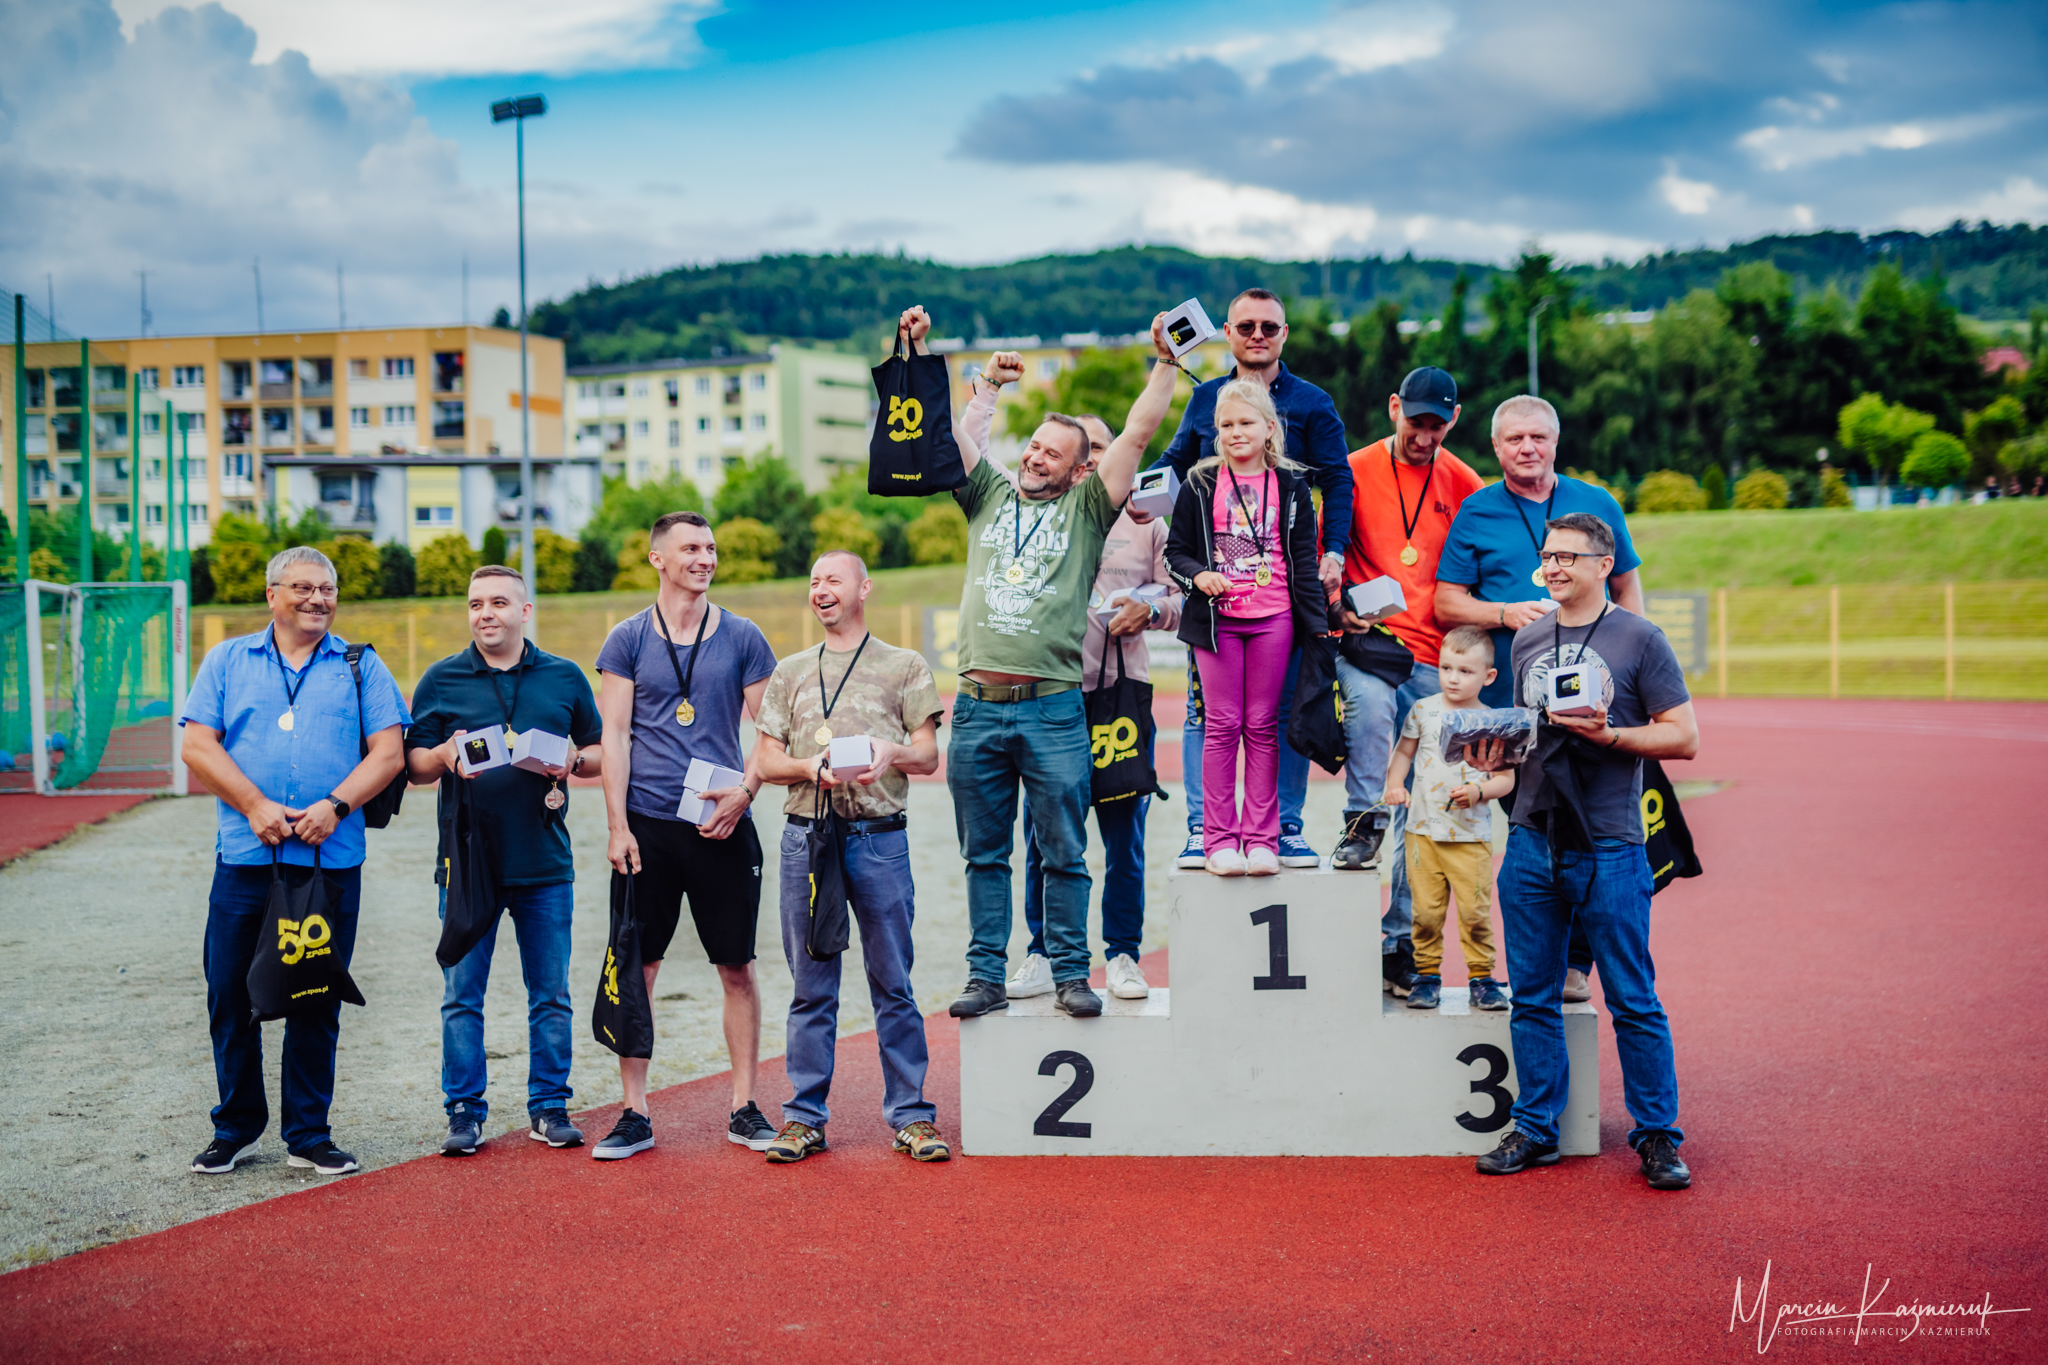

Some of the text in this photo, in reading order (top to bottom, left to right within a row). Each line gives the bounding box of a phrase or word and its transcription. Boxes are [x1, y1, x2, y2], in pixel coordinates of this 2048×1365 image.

[887, 395, 923, 442] 50
[988, 614, 1033, 627] CAMOSHOP
[1091, 716, 1138, 769] 50
[278, 914, 331, 965] 50
[306, 947, 331, 959] ZPAS
[1250, 904, 1307, 990] 1
[291, 985, 329, 999] www.zpas.pl
[1033, 1049, 1095, 1139] 2
[1455, 1043, 1515, 1134] 3
